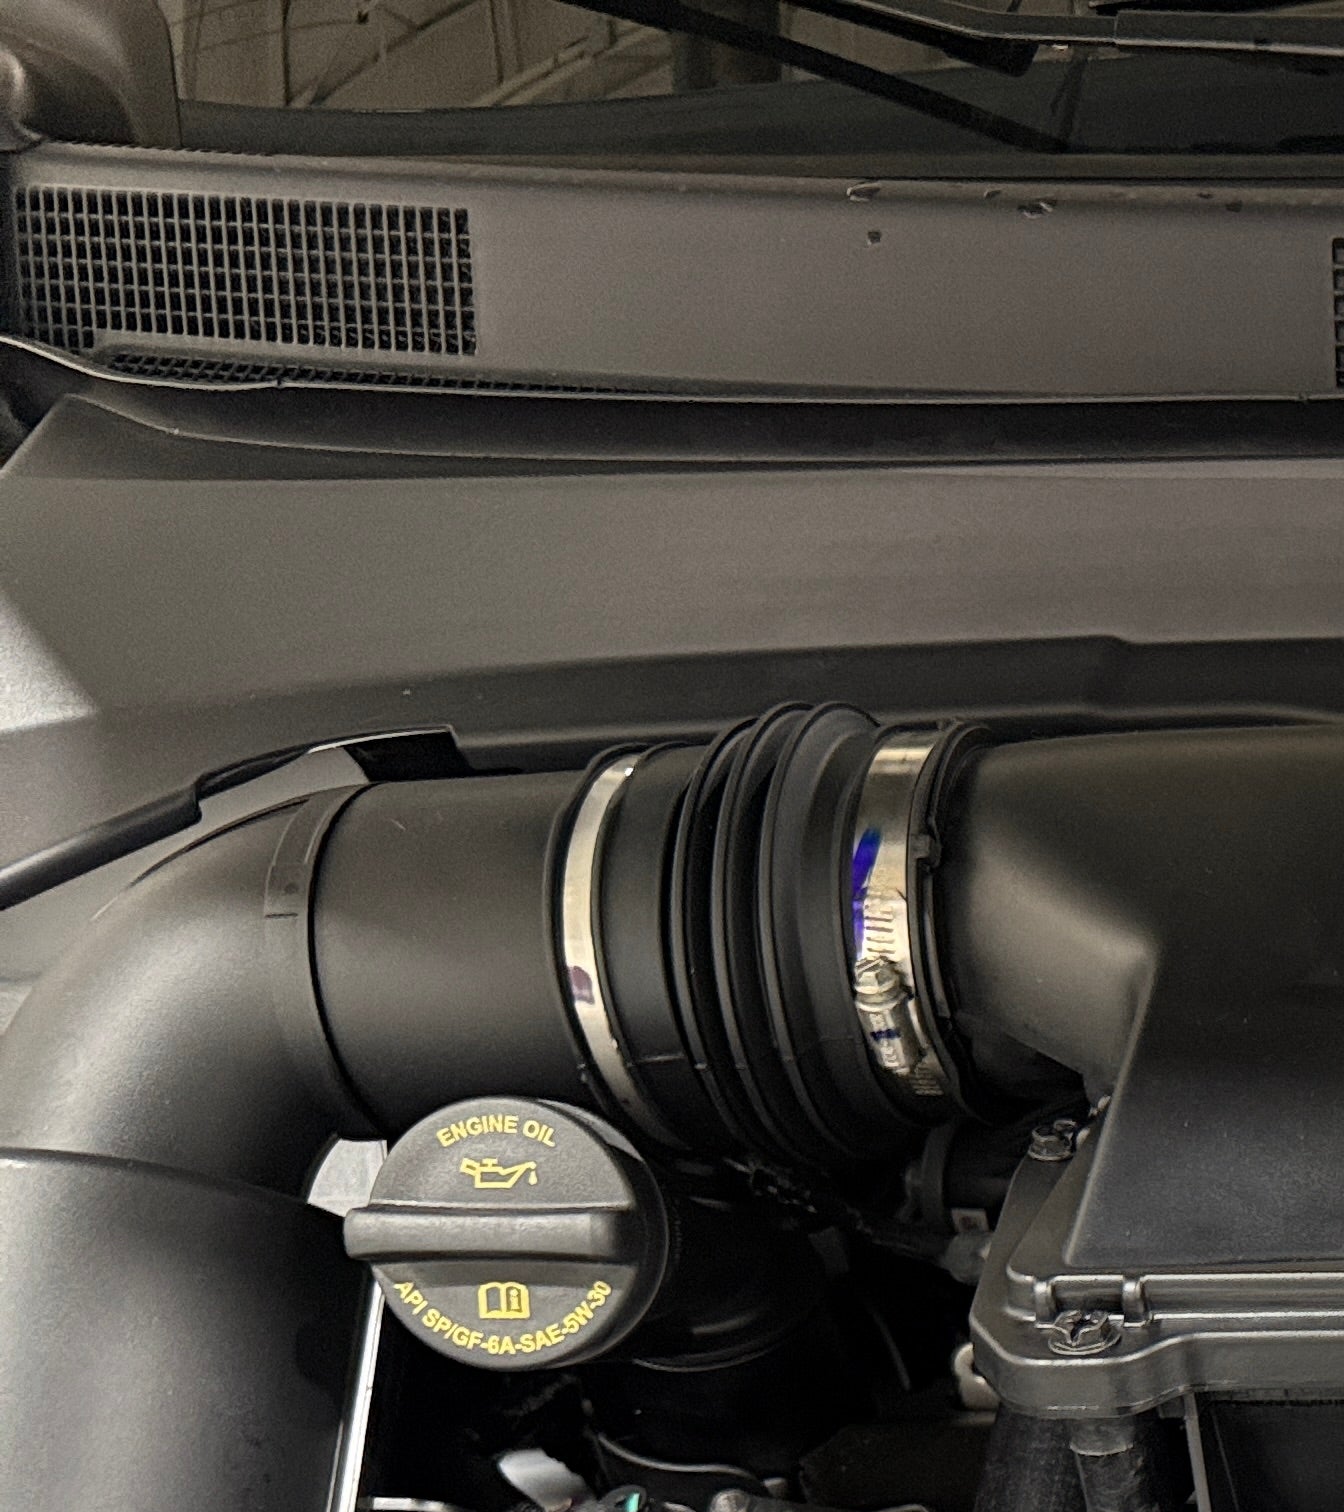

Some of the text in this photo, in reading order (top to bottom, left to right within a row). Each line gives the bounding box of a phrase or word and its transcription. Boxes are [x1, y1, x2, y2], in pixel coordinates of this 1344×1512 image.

[436, 1115, 556, 1149] ENGINE OIL
[393, 1280, 430, 1316] API
